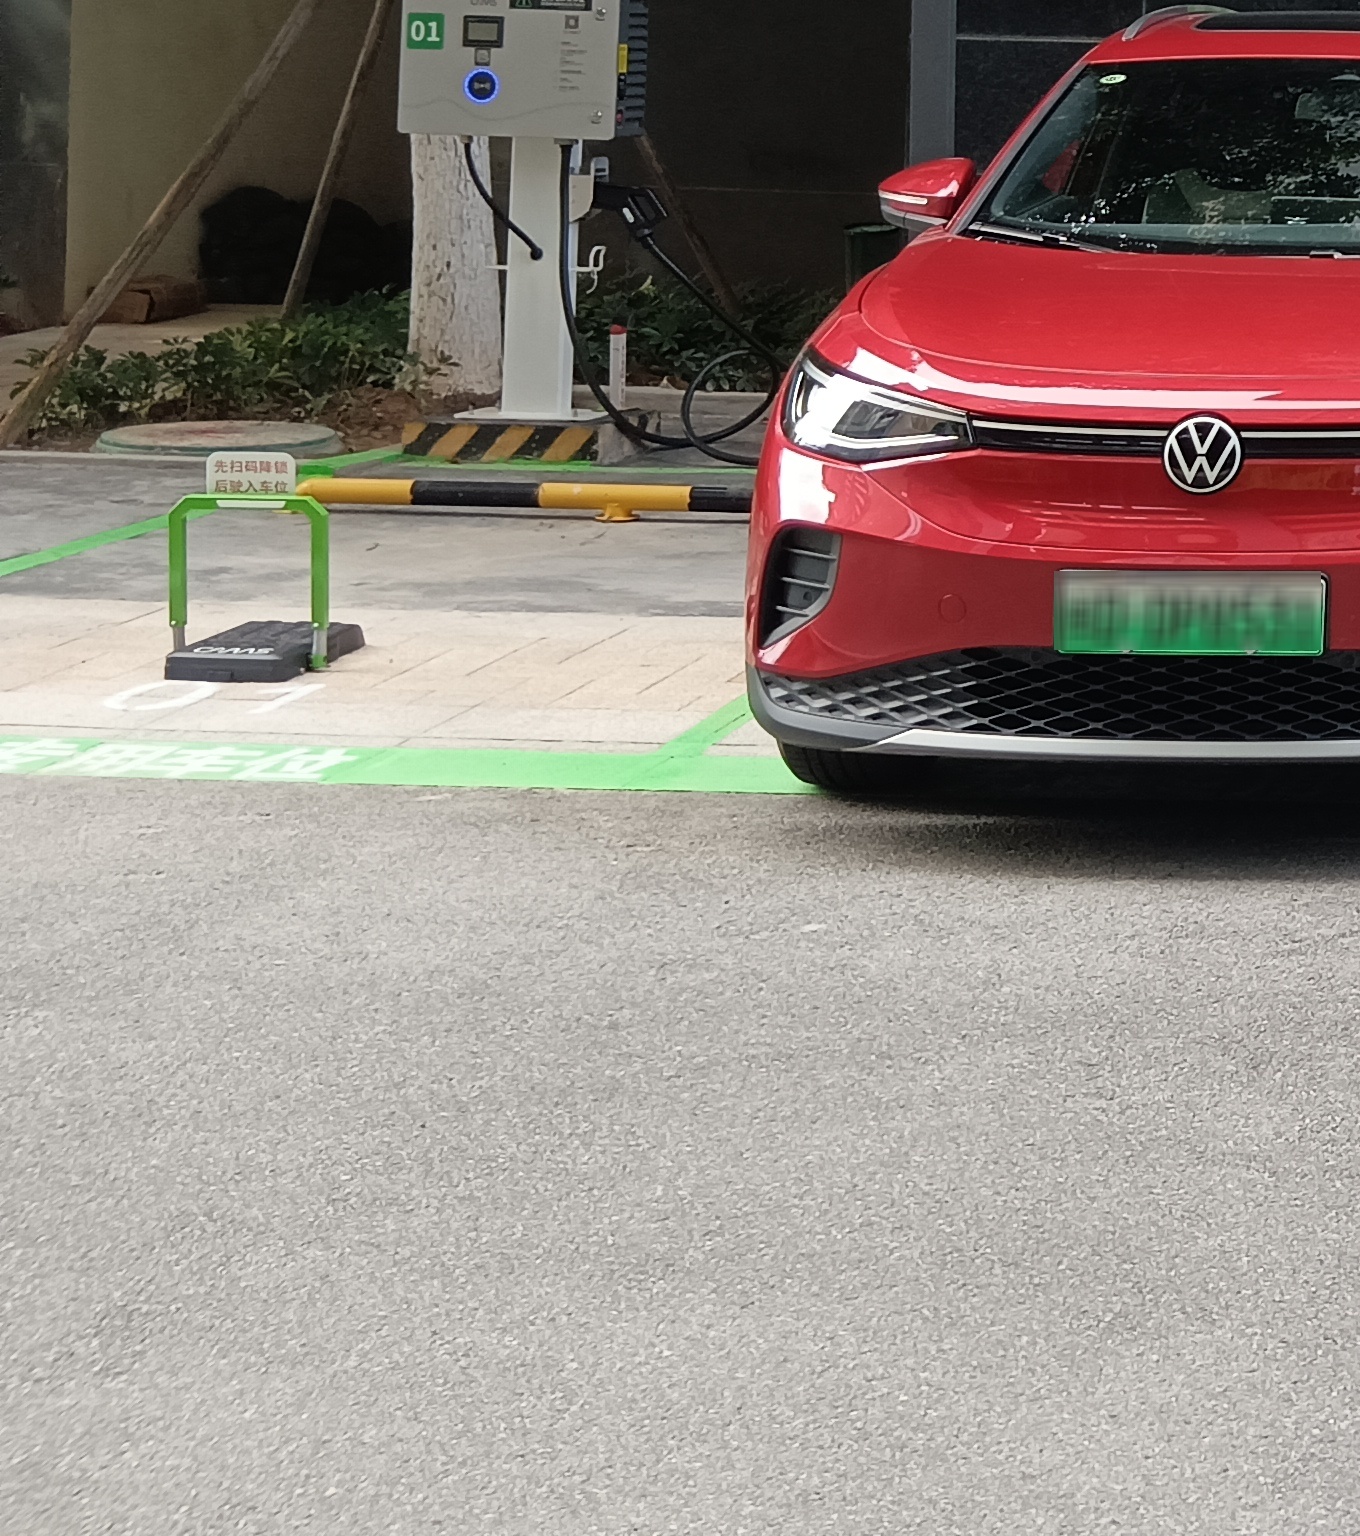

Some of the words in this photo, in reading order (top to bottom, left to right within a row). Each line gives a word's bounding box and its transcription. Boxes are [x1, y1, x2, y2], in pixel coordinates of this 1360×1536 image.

[411, 20, 440, 42] 01
[214, 459, 288, 474] 先扫码降锁
[214, 479, 288, 494] 后驶入车位
[103, 680, 326, 714] 01
